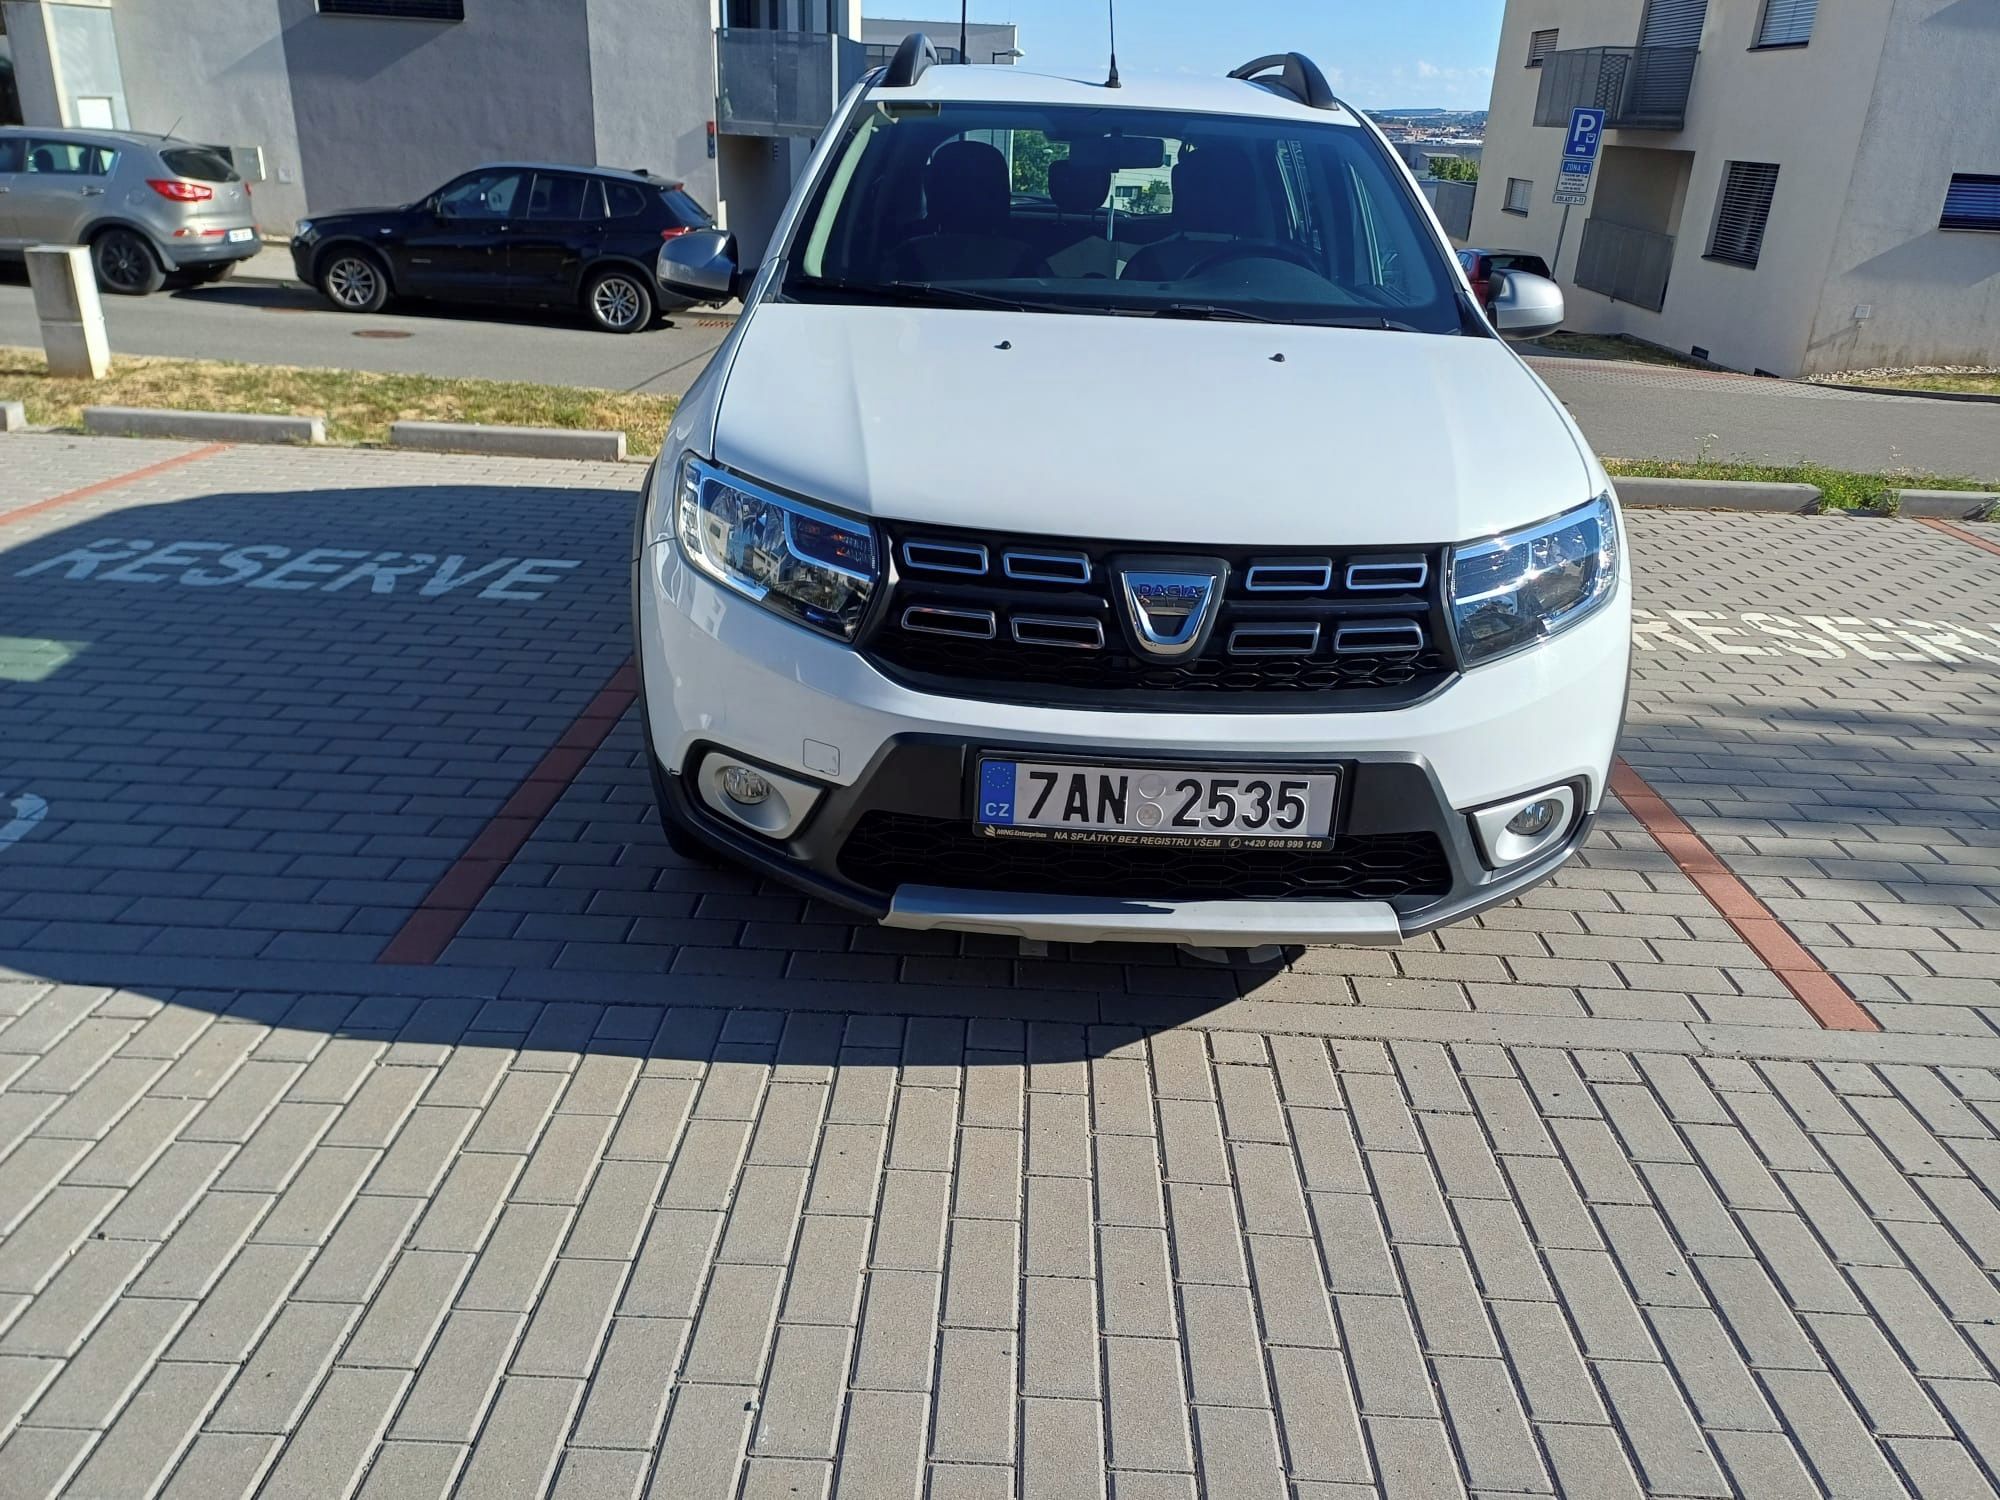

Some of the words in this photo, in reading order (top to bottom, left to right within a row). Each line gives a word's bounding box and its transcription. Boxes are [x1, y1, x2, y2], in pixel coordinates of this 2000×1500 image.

[1573, 114, 1596, 142] P
[14, 538, 582, 600] RESERVE
[1138, 584, 1199, 598] DACIA
[1027, 771, 1129, 825] 7AN
[1171, 778, 1309, 830] 2535
[985, 803, 1010, 817] CZ
[1054, 832, 1068, 840] NA
[1070, 832, 1116, 843] SPLÁTKY
[1118, 835, 1138, 844] BEZ
[1140, 836, 1191, 846] REGISTRU
[1194, 837, 1221, 847] VŠEM
[1268, 840, 1284, 848] 608
[1287, 840, 1304, 848] 999
[1306, 841, 1323, 849] 158
